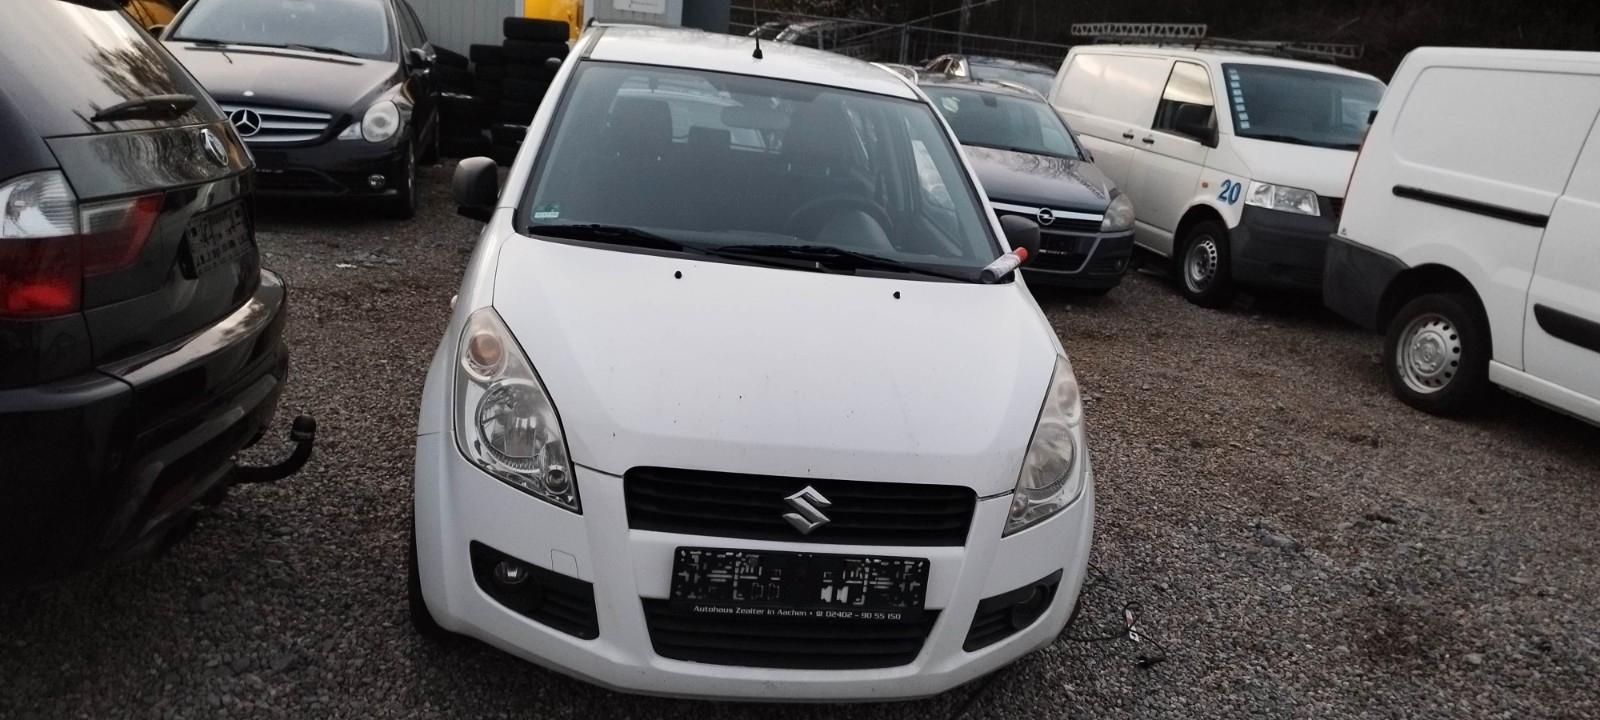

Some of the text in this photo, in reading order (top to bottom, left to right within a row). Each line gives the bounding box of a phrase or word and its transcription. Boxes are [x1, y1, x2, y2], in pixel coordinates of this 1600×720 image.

[1217, 179, 1242, 206] 20
[693, 605, 733, 614] Autohaus
[777, 608, 807, 617] Aachen
[825, 610, 853, 618] 02402
[874, 612, 885, 620] 55
